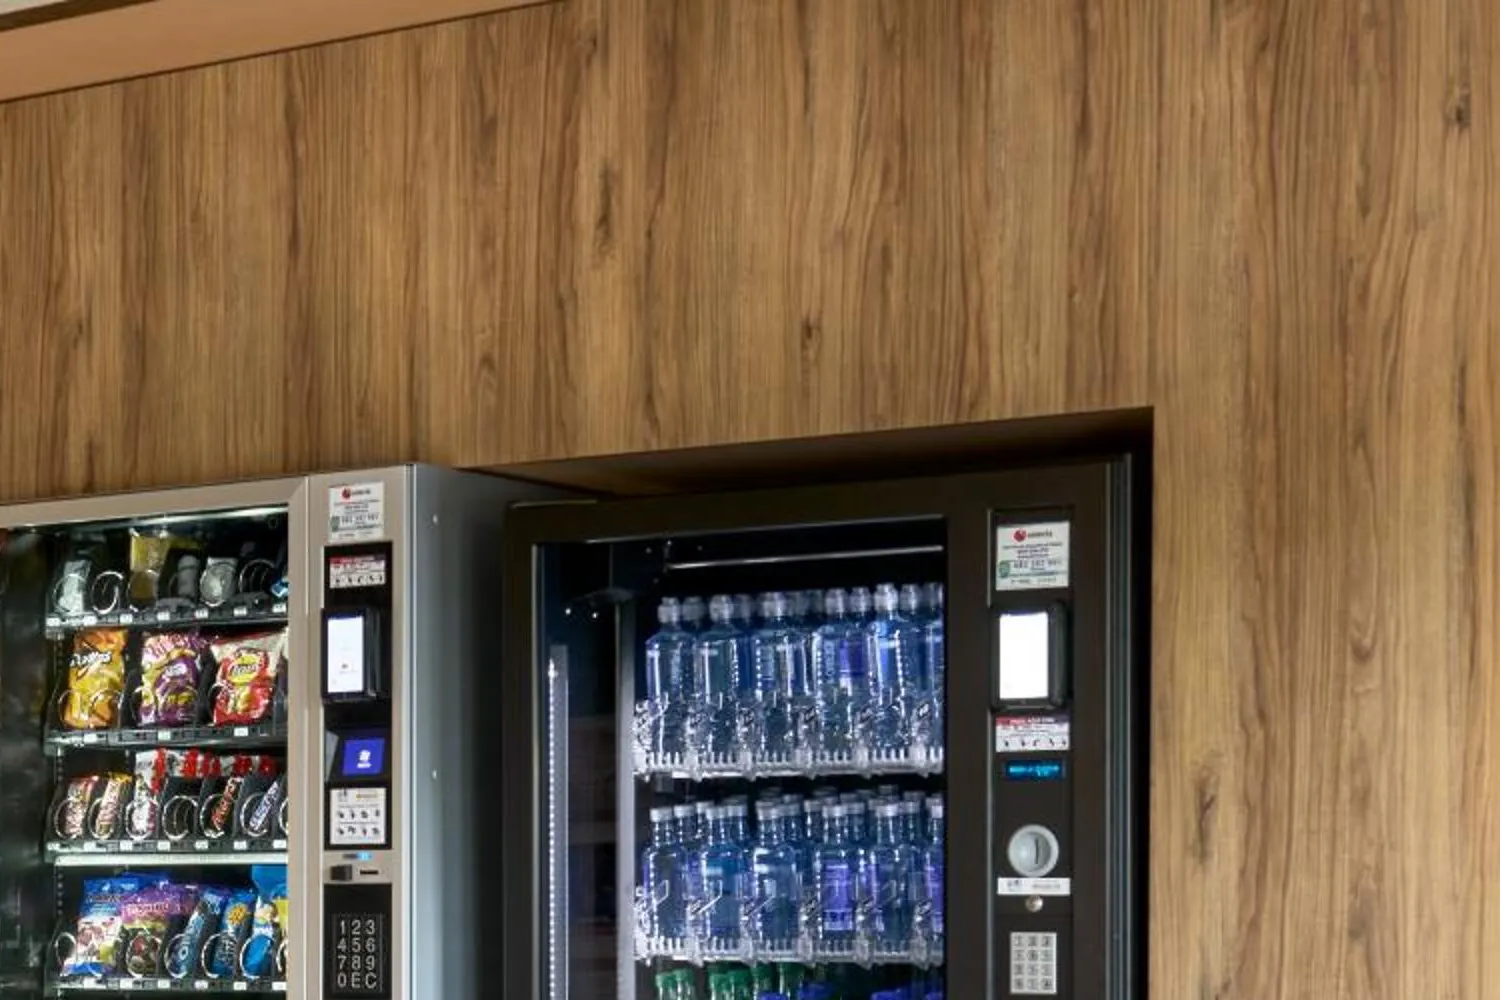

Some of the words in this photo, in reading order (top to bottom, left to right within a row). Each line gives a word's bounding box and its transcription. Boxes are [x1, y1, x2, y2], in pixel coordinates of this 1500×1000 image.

[340, 919, 346, 935] 1
[351, 919, 361, 936] 2
[365, 919, 376, 935] 3
[337, 937, 347, 952] 4
[351, 937, 361, 953] 5
[365, 937, 376, 953] 6
[337, 954, 347, 970] 7
[351, 954, 361, 971] 8
[365, 954, 376, 971] 9
[337, 972, 347, 988] 0
[351, 971, 361, 989] E
[364, 971, 377, 989] C
